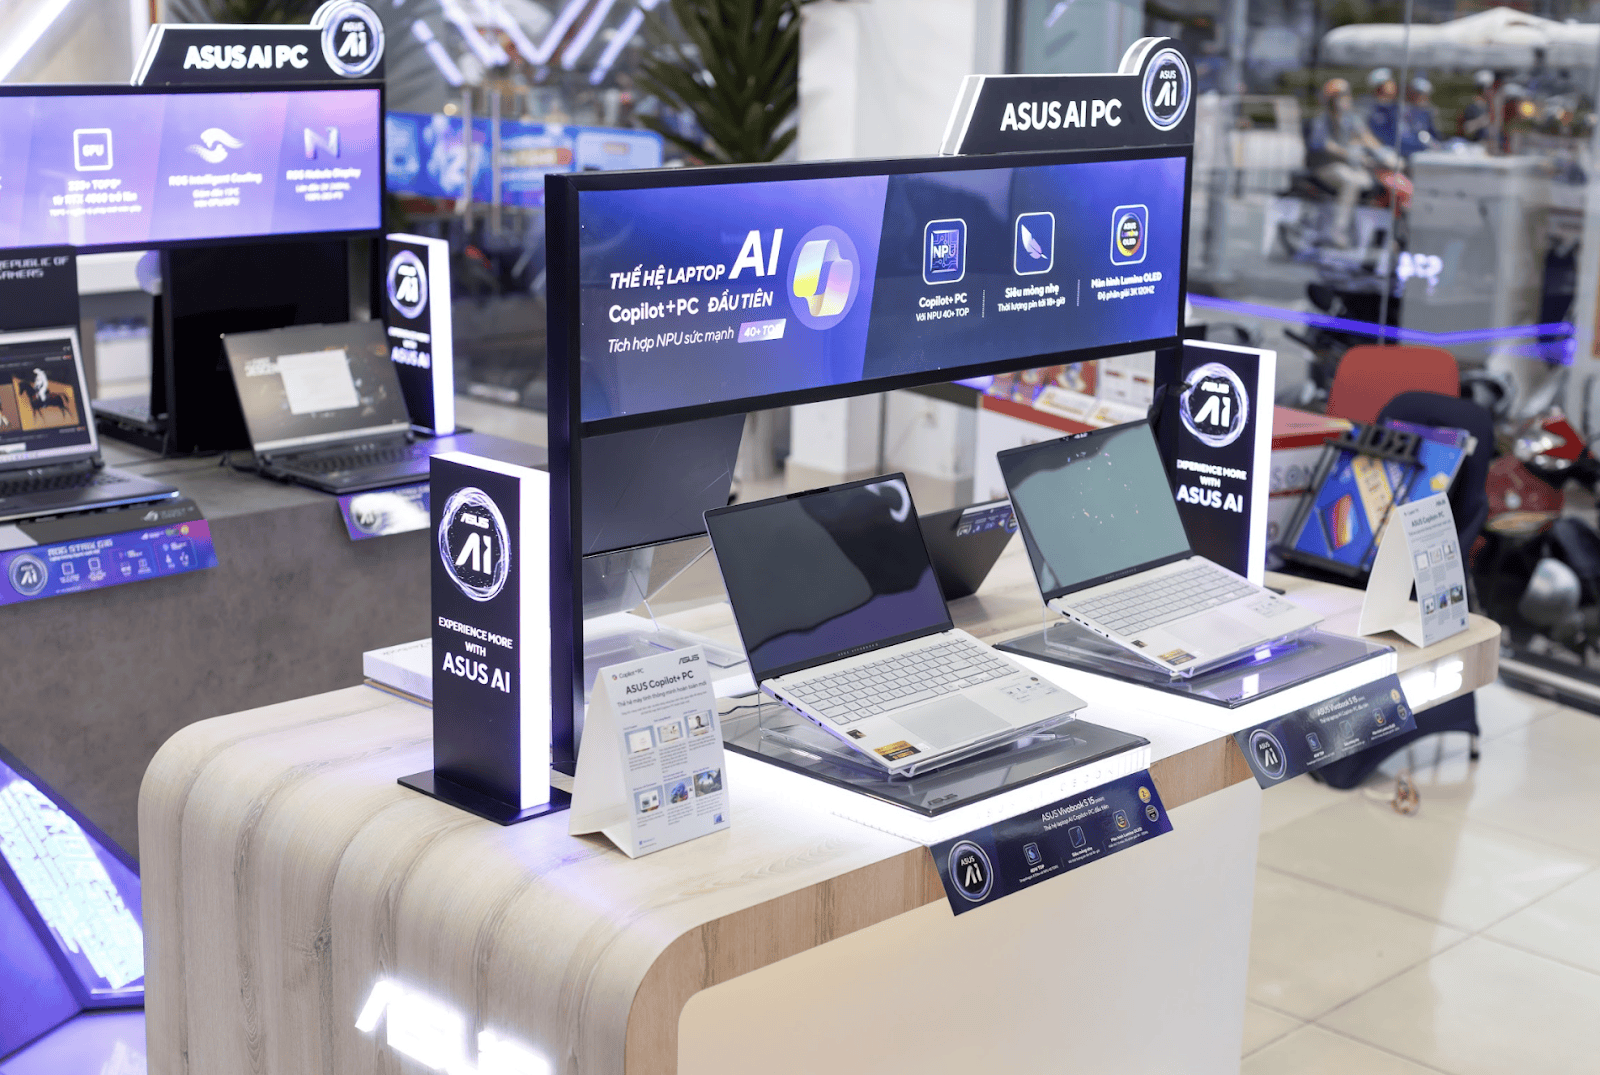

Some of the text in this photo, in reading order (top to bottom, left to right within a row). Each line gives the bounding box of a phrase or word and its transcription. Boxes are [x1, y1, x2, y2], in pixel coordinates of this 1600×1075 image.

[183, 44, 309, 70] ASUS AI PC
[1159, 70, 1176, 79] ASUS
[1000, 98, 1122, 131] ASUS AI PC
[609, 228, 784, 290] THẾ HỆ LAPTOP AI
[933, 244, 956, 259] NPU
[0, 257, 52, 270] EPUBLIC
[1120, 274, 1143, 286] Lumina
[1143, 271, 1163, 282] OLED
[707, 288, 739, 313] ĐẦU
[741, 287, 773, 309] TIÊN
[918, 292, 967, 309] Copilot+ PC
[1005, 286, 1022, 298] Siêu
[926, 309, 942, 320] NPU
[942, 308, 956, 319] 40+
[956, 307, 970, 317] TOP
[608, 338, 631, 353] Tích
[632, 336, 654, 353] hợp
[656, 331, 684, 348] NPU
[684, 329, 703, 344] sức
[704, 326, 734, 344] mạnh
[744, 326, 761, 338] 40+
[1199, 475, 1221, 488] WITH
[1222, 466, 1247, 481] MORE
[1176, 484, 1244, 513] ASUS AI
[460, 512, 490, 529] ASUS
[438, 616, 513, 649] EXPERIENCE MORE
[464, 641, 487, 657] WITH
[678, 654, 700, 665] ASUS
[442, 652, 511, 693] ASUS AI
[625, 670, 694, 695] ASUS Copilot+ PC
[1041, 809, 1059, 822] ASUS
[1056, 800, 1084, 816] Vivobook
[1083, 798, 1089, 807] S
[1088, 796, 1096, 805] 15
[960, 855, 976, 867] ASUS
